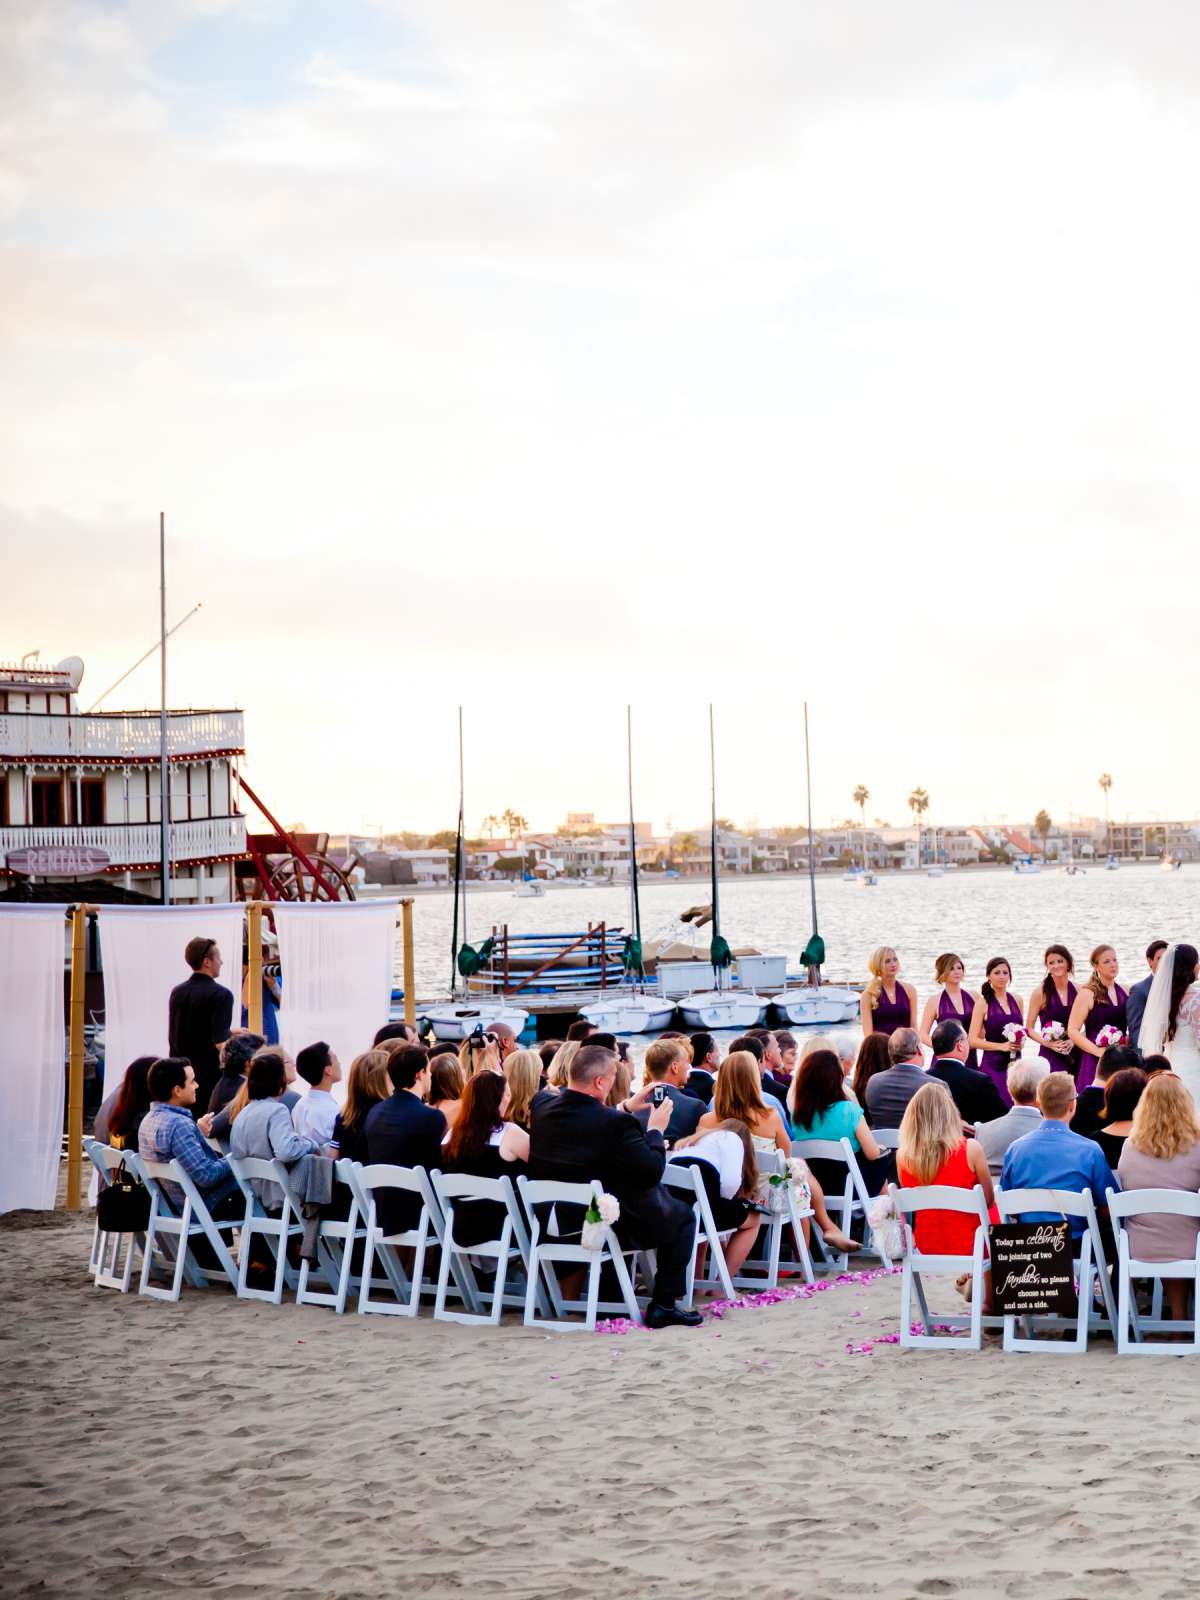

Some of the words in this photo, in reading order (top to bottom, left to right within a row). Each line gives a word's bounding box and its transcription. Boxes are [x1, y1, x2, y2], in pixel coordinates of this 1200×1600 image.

[27, 849, 95, 873] RENTALS
[995, 1239, 1014, 1247] Today
[1026, 1225, 1065, 1252] celebrate
[1009, 1253, 1031, 1262] joining
[1049, 1275, 1070, 1284] please
